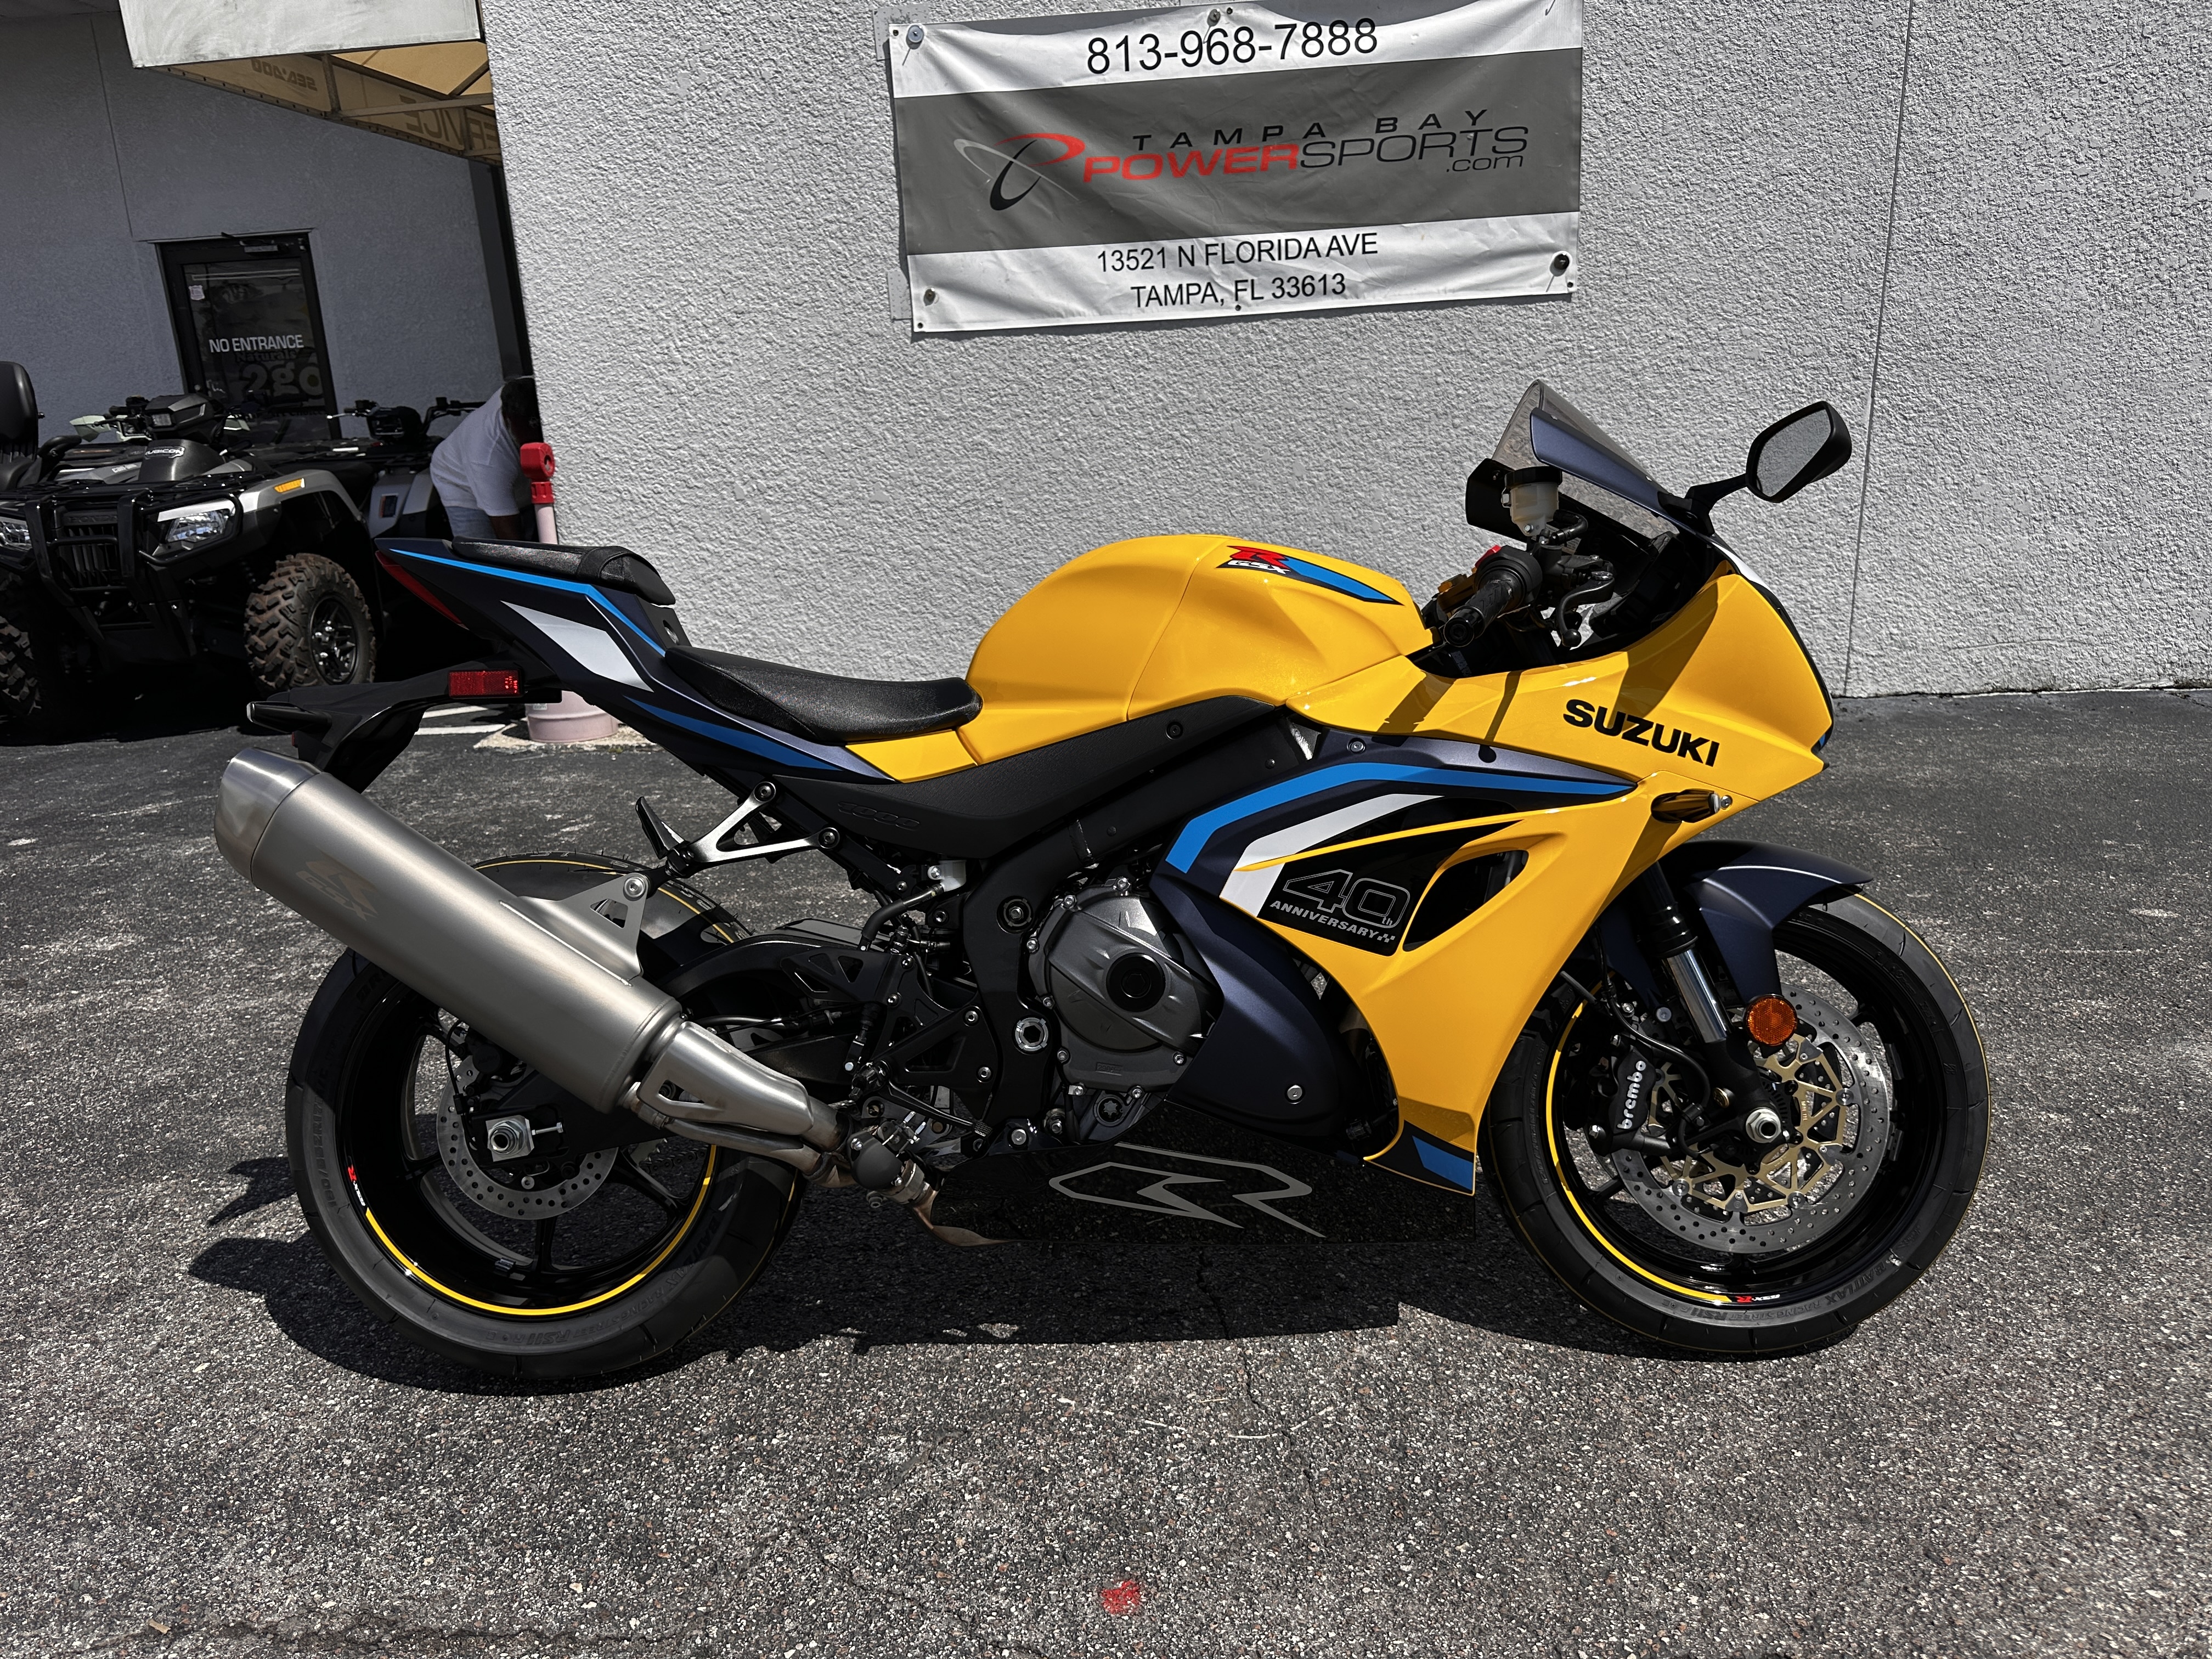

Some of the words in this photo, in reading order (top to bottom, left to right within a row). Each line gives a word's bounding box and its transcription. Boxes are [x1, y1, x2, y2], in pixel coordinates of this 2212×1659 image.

[1087, 18, 1378, 75] 813-968-7888
[1133, 122, 1328, 150] TAMPA
[1376, 110, 1488, 133] BAY
[1083, 126, 1529, 183] POWERSPORTS
[1446, 153, 1523, 173] .com
[1097, 247, 1167, 273] 13521
[1178, 245, 1195, 267] N
[1206, 237, 1321, 266] FLORIDA
[1325, 233, 1378, 257] AVE
[1131, 282, 1224, 308] TAMPA,
[1234, 280, 1264, 303] FL
[1271, 273, 1346, 299] 33613
[208, 338, 230, 353] NO
[232, 335, 304, 352] ENTRANCE
[1227, 560, 1291, 574] GSX
[1563, 699, 1720, 767] SUZUKI
[1270, 901, 1379, 939] ANNIVERSARY
[1617, 1060, 1646, 1129] brembo
